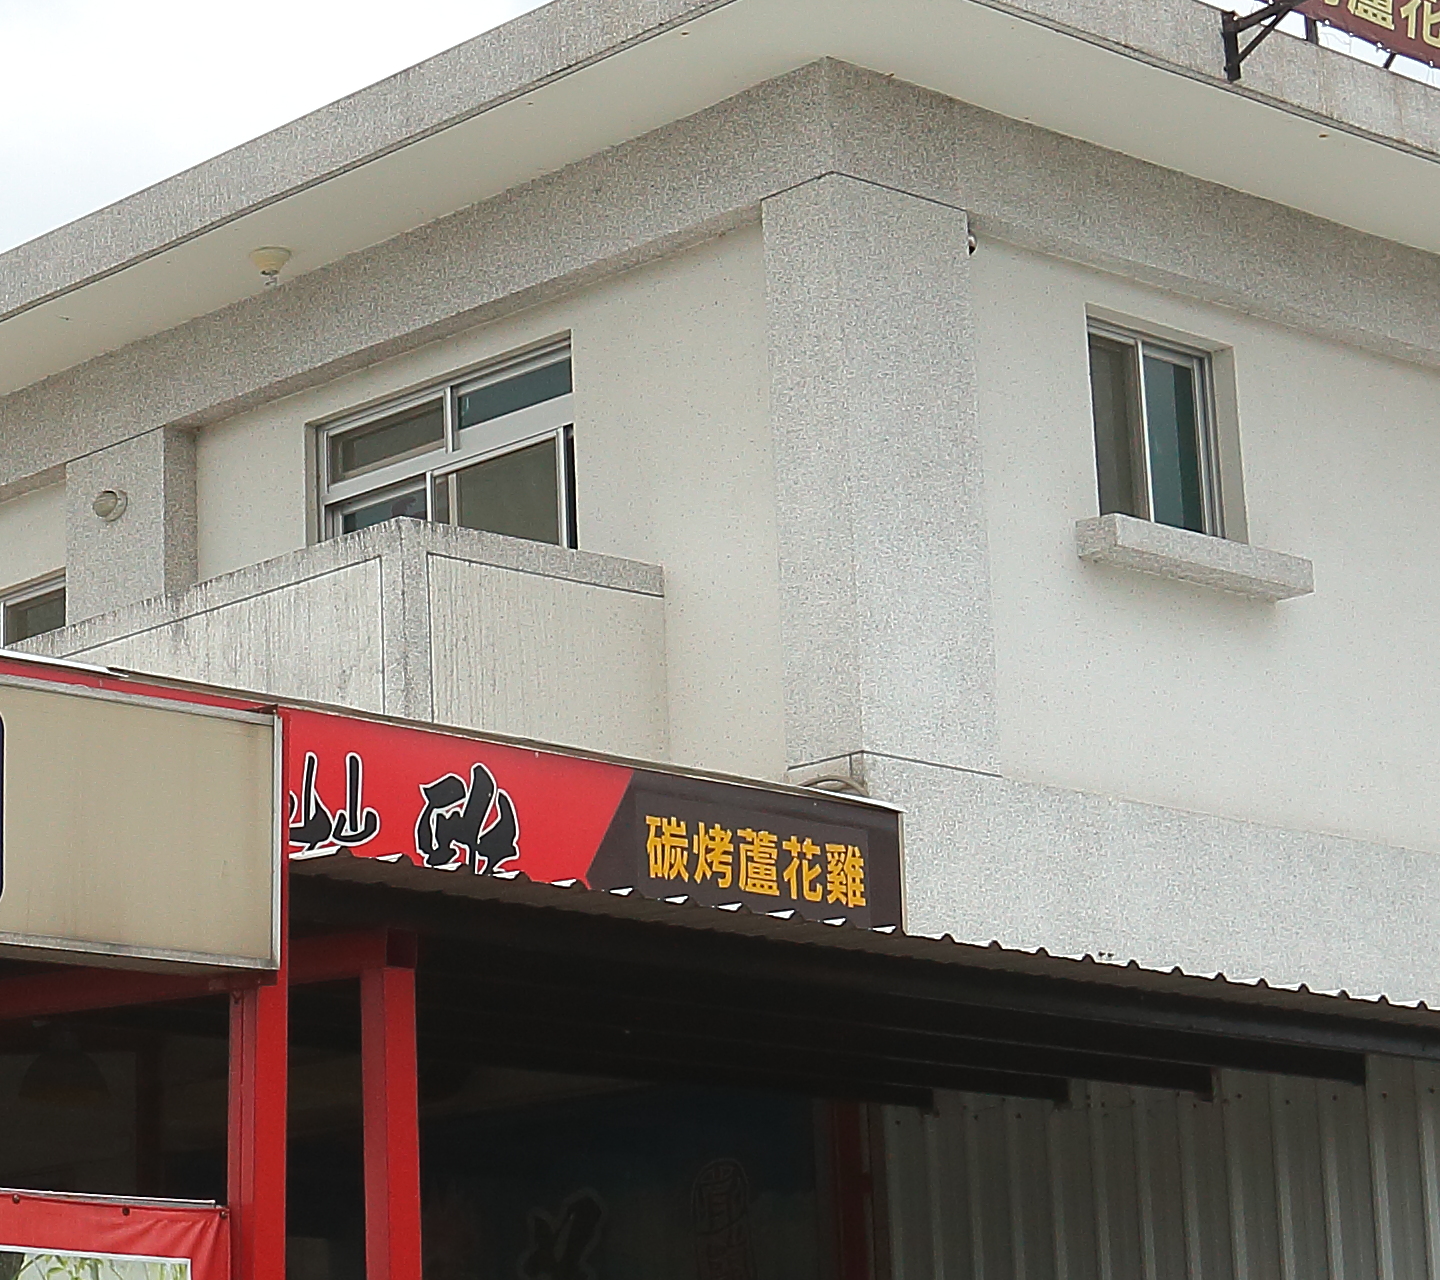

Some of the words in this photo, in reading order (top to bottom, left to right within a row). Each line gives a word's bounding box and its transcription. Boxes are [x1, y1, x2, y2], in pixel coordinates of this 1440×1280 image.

[645, 815, 867, 909] 碳烤蘆花雞
